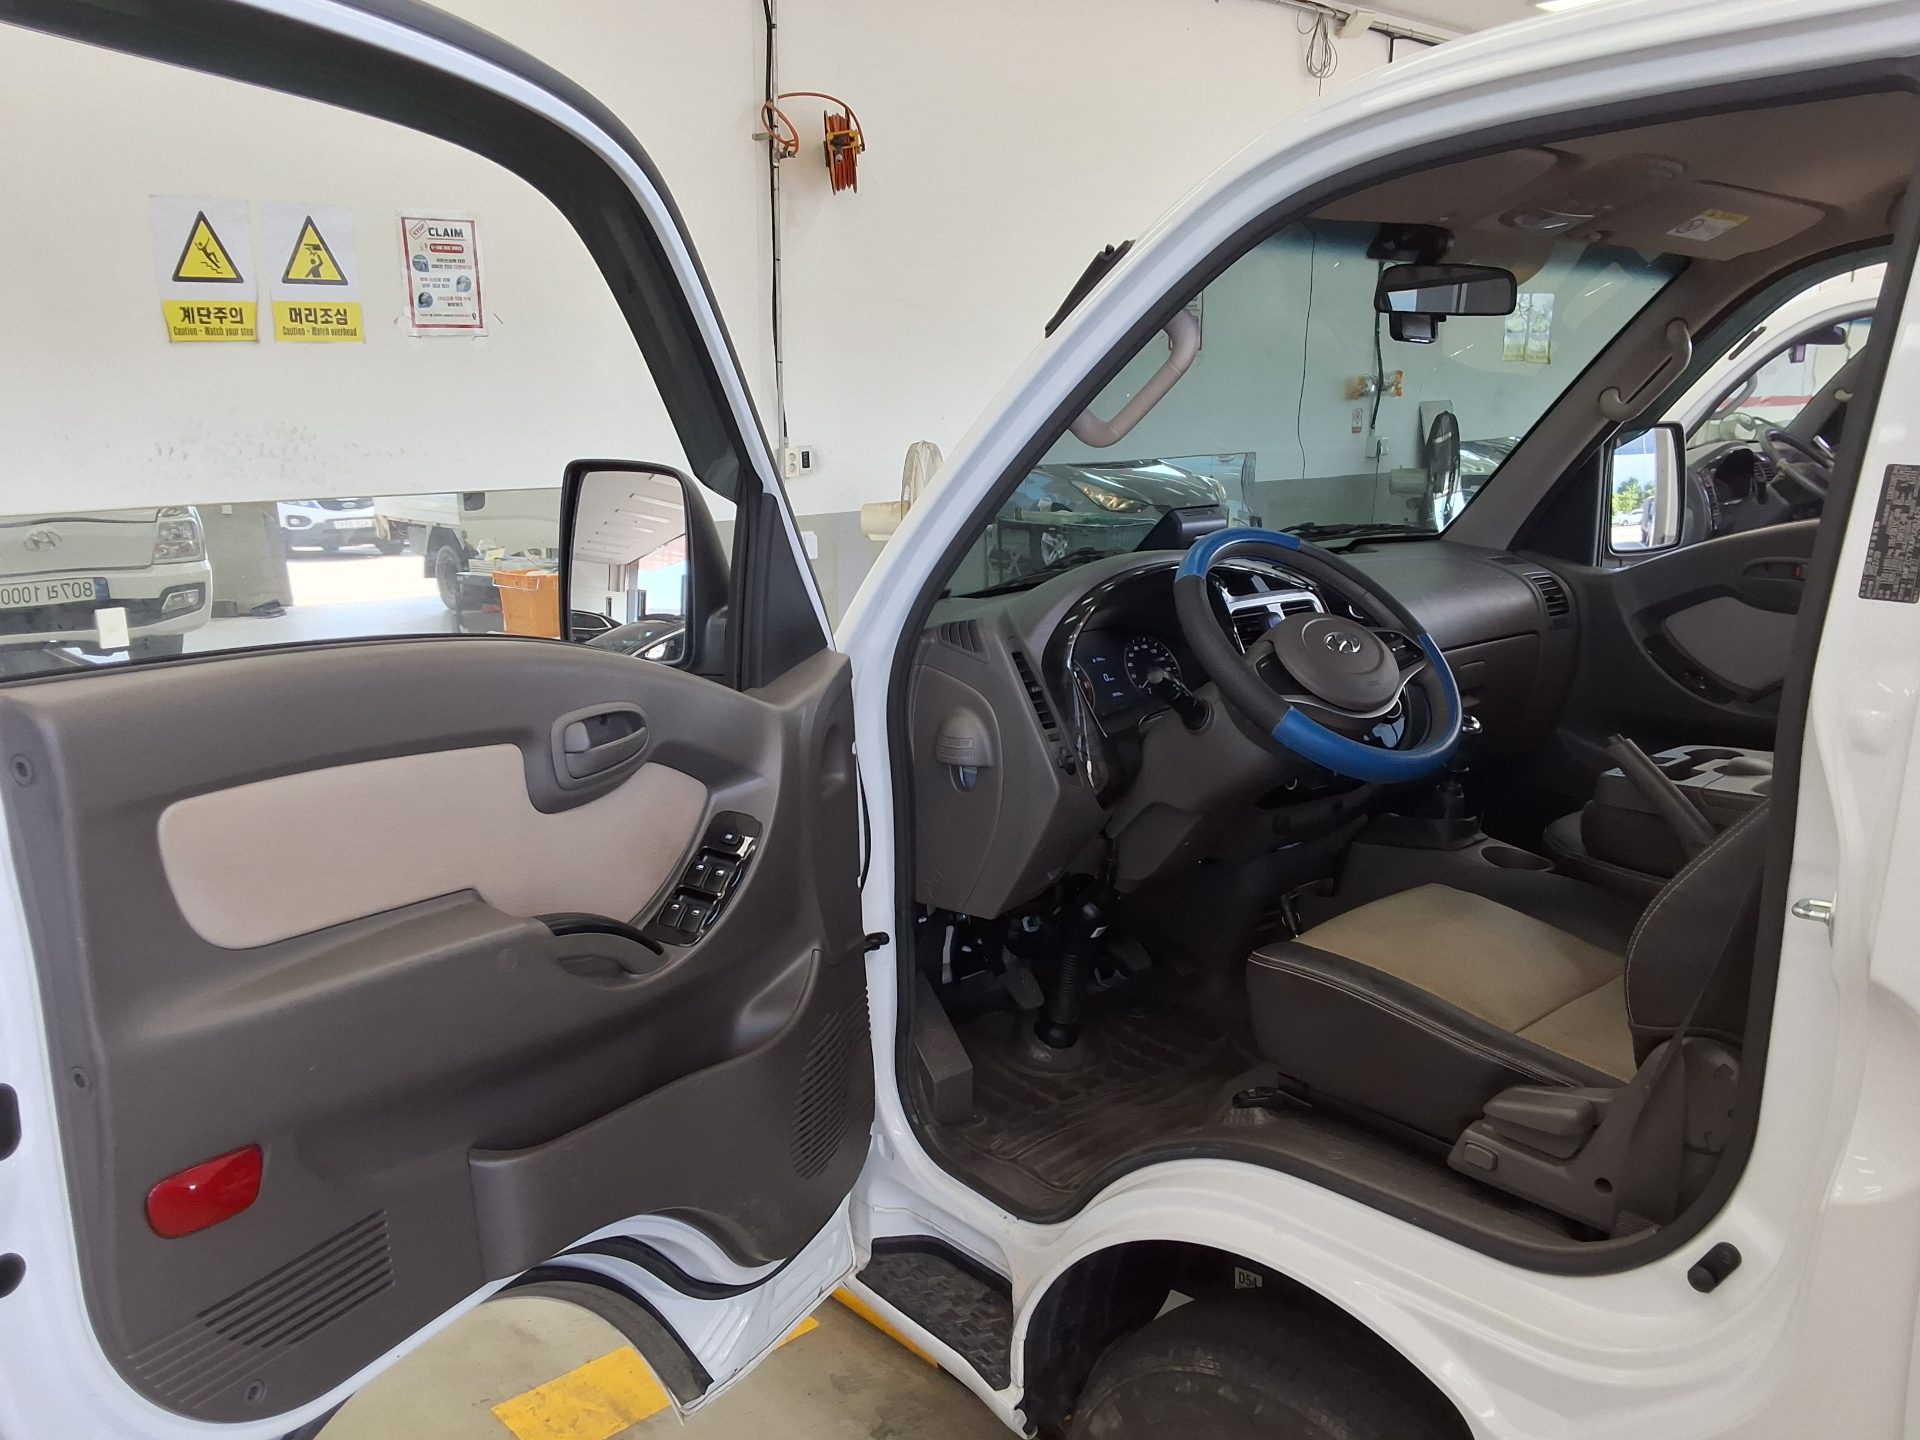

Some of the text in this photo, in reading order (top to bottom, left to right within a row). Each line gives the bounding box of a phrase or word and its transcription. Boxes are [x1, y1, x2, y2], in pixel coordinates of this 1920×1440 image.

[428, 227, 464, 238] CLAIM
[179, 306, 244, 325] 계단주의
[288, 307, 349, 326] 머리조심
[173, 326, 198, 338] Caution
[204, 326, 224, 338] Watch
[226, 327, 240, 339] your
[241, 327, 254, 338] step
[282, 326, 306, 338] Caution
[311, 326, 330, 338] Watch
[330, 327, 358, 338] overhead
